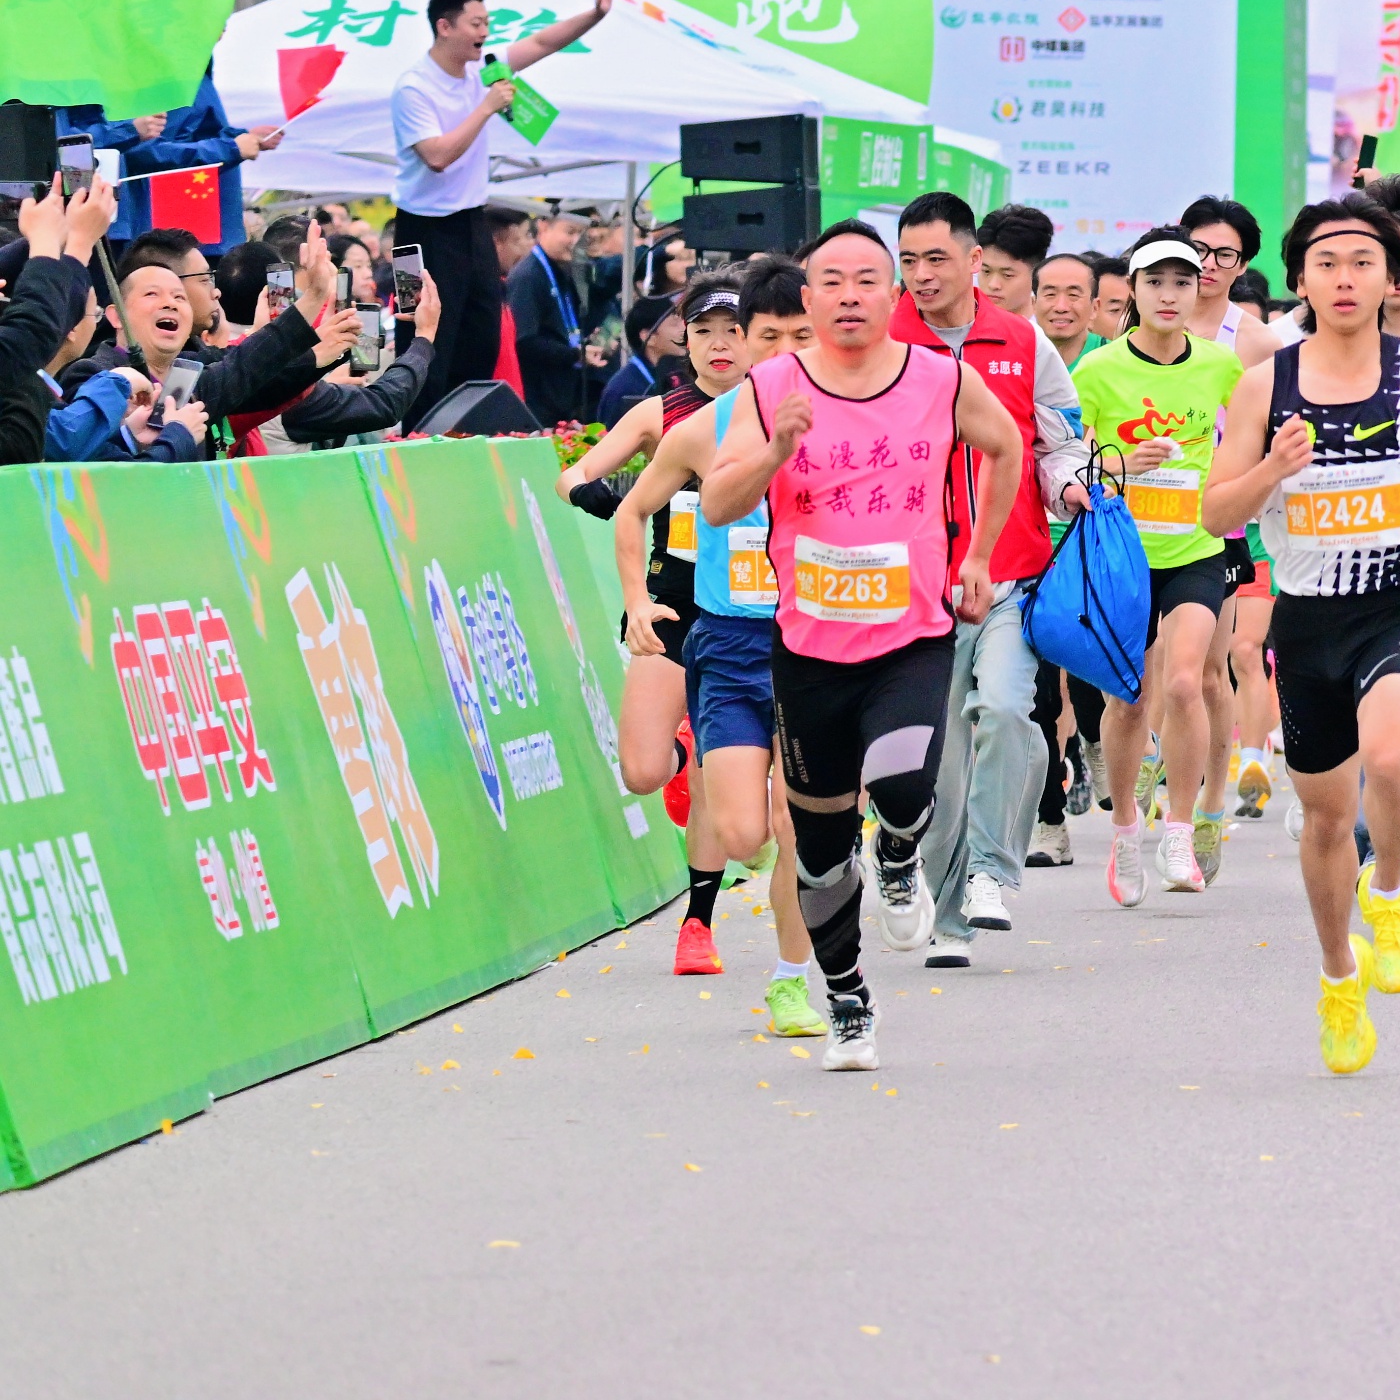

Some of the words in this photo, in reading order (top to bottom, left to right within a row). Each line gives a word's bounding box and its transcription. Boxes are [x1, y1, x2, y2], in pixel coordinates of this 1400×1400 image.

[1016, 160, 1111, 176] ZEEKR
[988, 360, 1024, 376] 志愿者
[792, 434, 931, 476] 春漫花田
[795, 480, 927, 517] 悠哉乐骑
[1132, 489, 1180, 517] 3018
[1315, 492, 1386, 529] 2424
[823, 572, 888, 603] 2263
[109, 597, 277, 817] 中国平安
